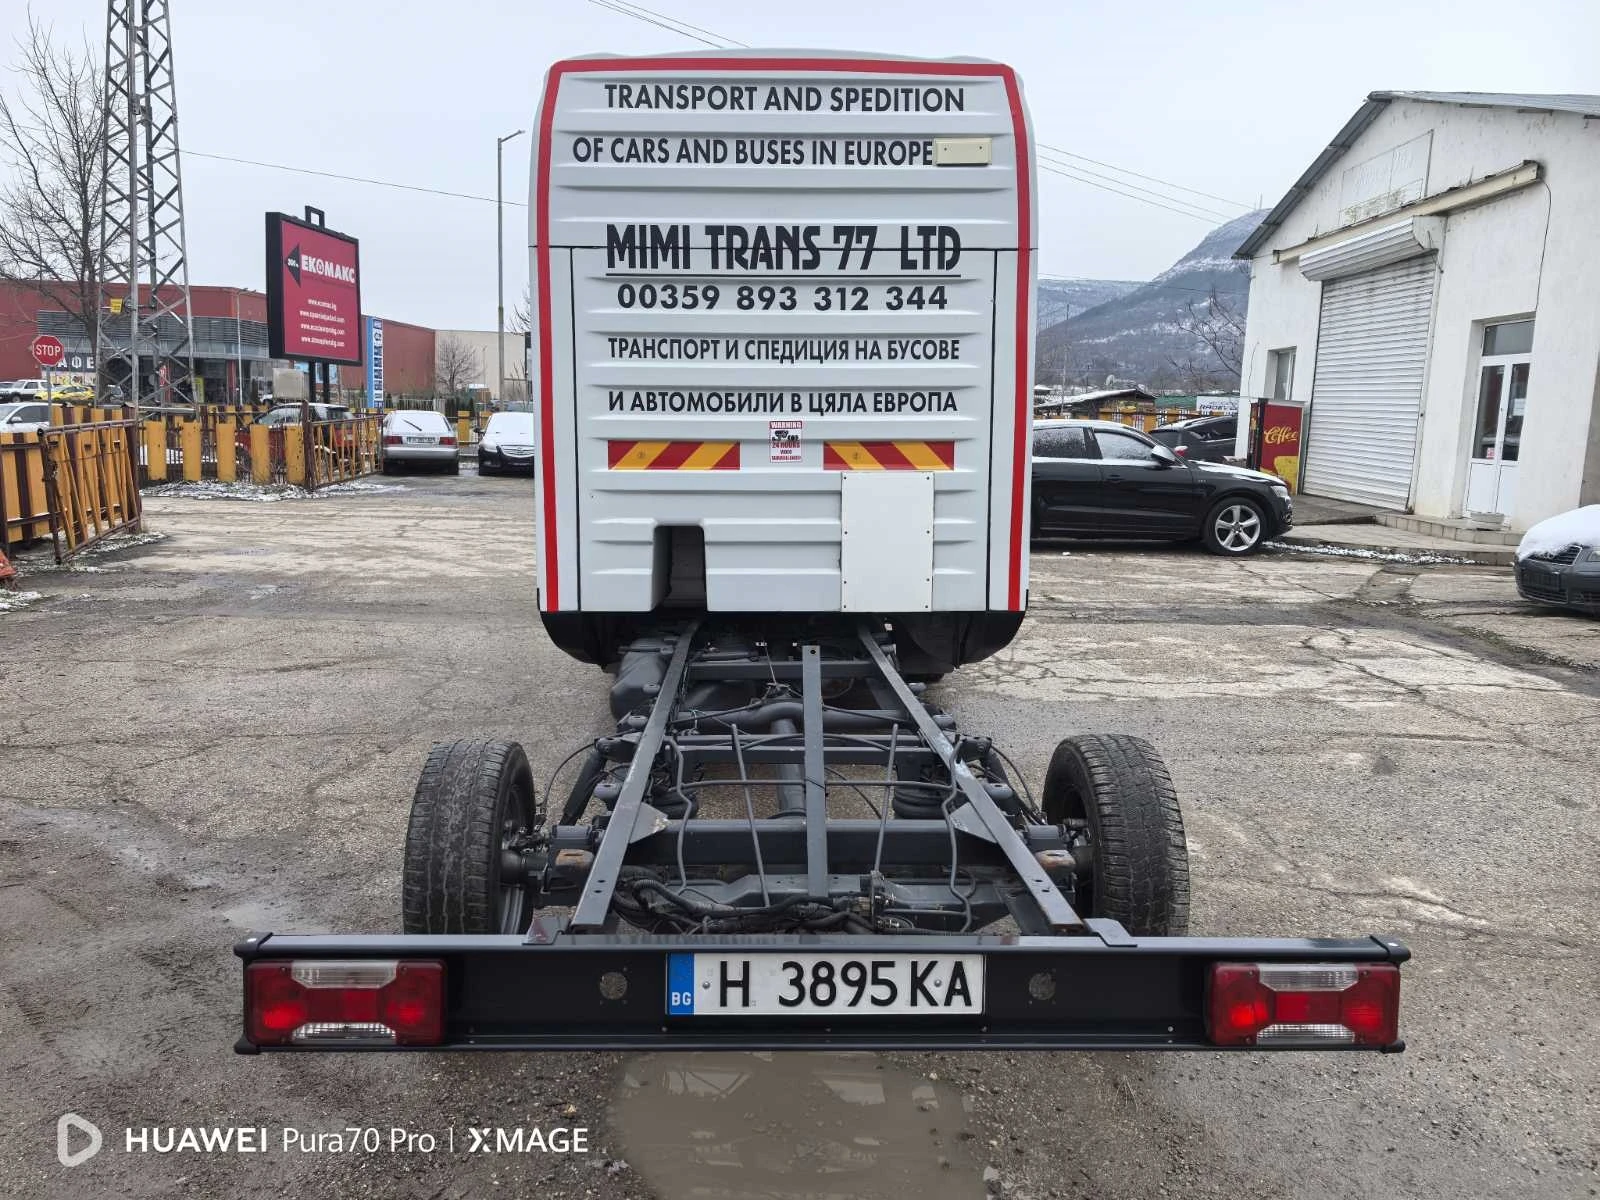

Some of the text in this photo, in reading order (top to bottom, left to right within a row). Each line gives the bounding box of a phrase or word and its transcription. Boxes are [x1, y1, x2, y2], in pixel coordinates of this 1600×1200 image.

[604, 84, 964, 112] TRANSPORT AND SPEDITION
[573, 137, 933, 165] OF CARS AND BUSES IN EUROPE
[607, 224, 961, 270] MIMI TRANS 77 LTD
[301, 255, 355, 283] ЕКОМАКС
[617, 284, 948, 311] 00359 893 312 344
[36, 345, 60, 356] STOP
[58, 356, 94, 368] АФЕ
[608, 337, 960, 363] ТРАНСПОРТ И СПЕДИЦИЯ НА БУСОВЕ
[609, 392, 957, 416] И АВТОМОБИЛИ В ЦЯЛА ЕВРОПА
[1264, 426, 1298, 445] Coffee
[672, 992, 691, 1006] BG
